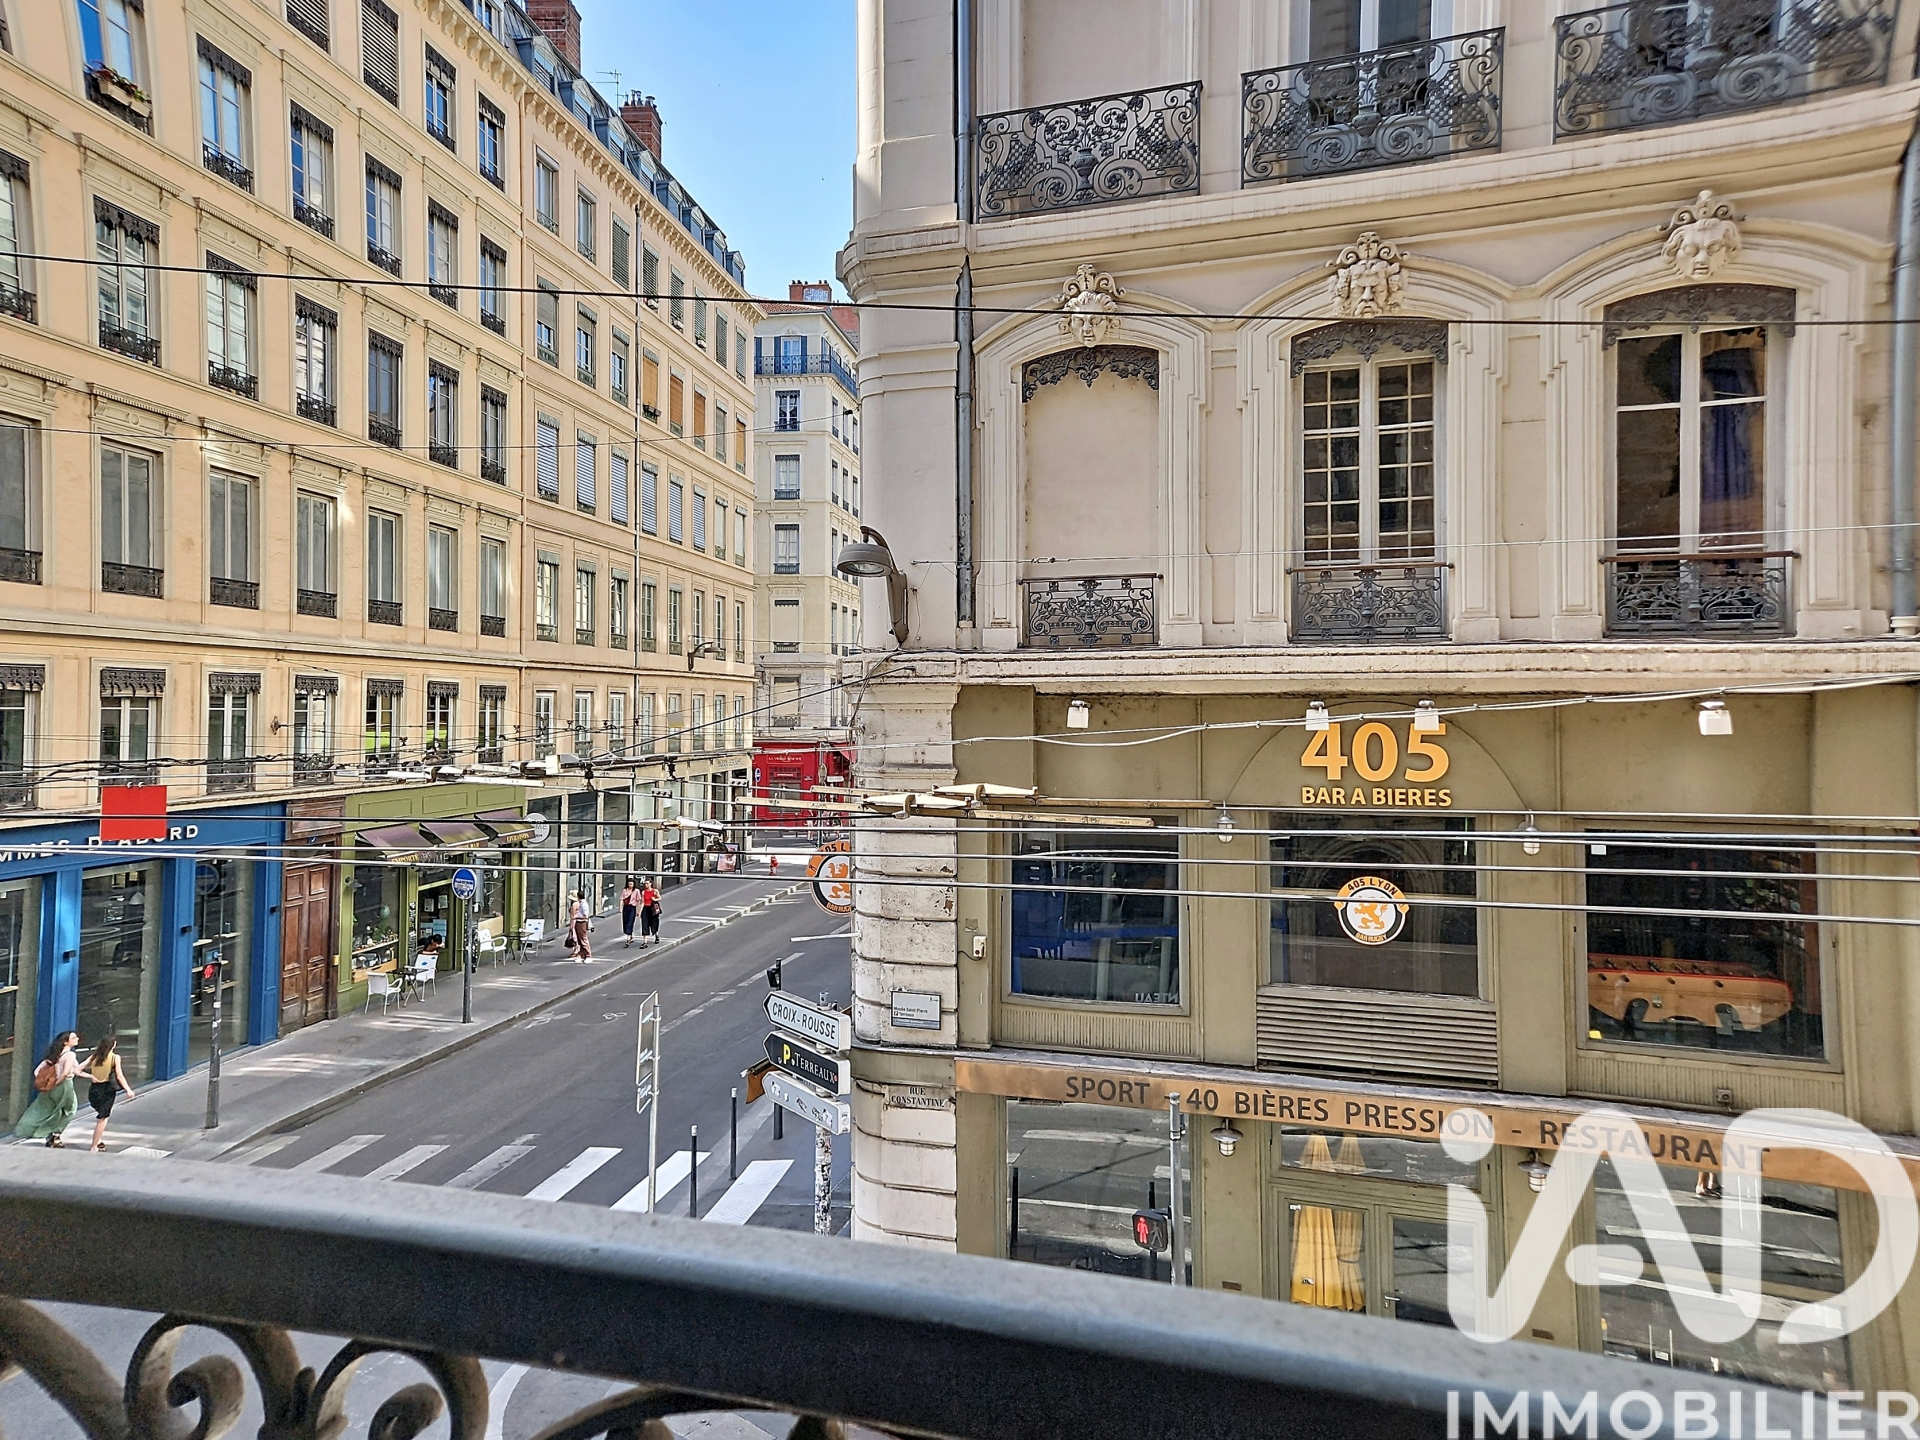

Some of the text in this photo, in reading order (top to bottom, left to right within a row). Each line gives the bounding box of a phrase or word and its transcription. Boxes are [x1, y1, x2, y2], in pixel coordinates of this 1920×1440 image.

[1301, 721, 1450, 783] 405
[1302, 786, 1452, 807] BAR A BIERES
[1347, 877, 1398, 896] 405 LYON
[772, 1002, 836, 1040] CROIX-ROUSSE
[891, 1095, 946, 1108] CONSTANTINE
[908, 1086, 926, 1096] RUE
[1065, 1076, 1150, 1105] SPORT
[1186, 1088, 1219, 1112] 40
[1235, 1089, 1329, 1122] BIÈRES
[1345, 1101, 1494, 1140] PRESSION
[1540, 1119, 1771, 1172] RESTAURANT
